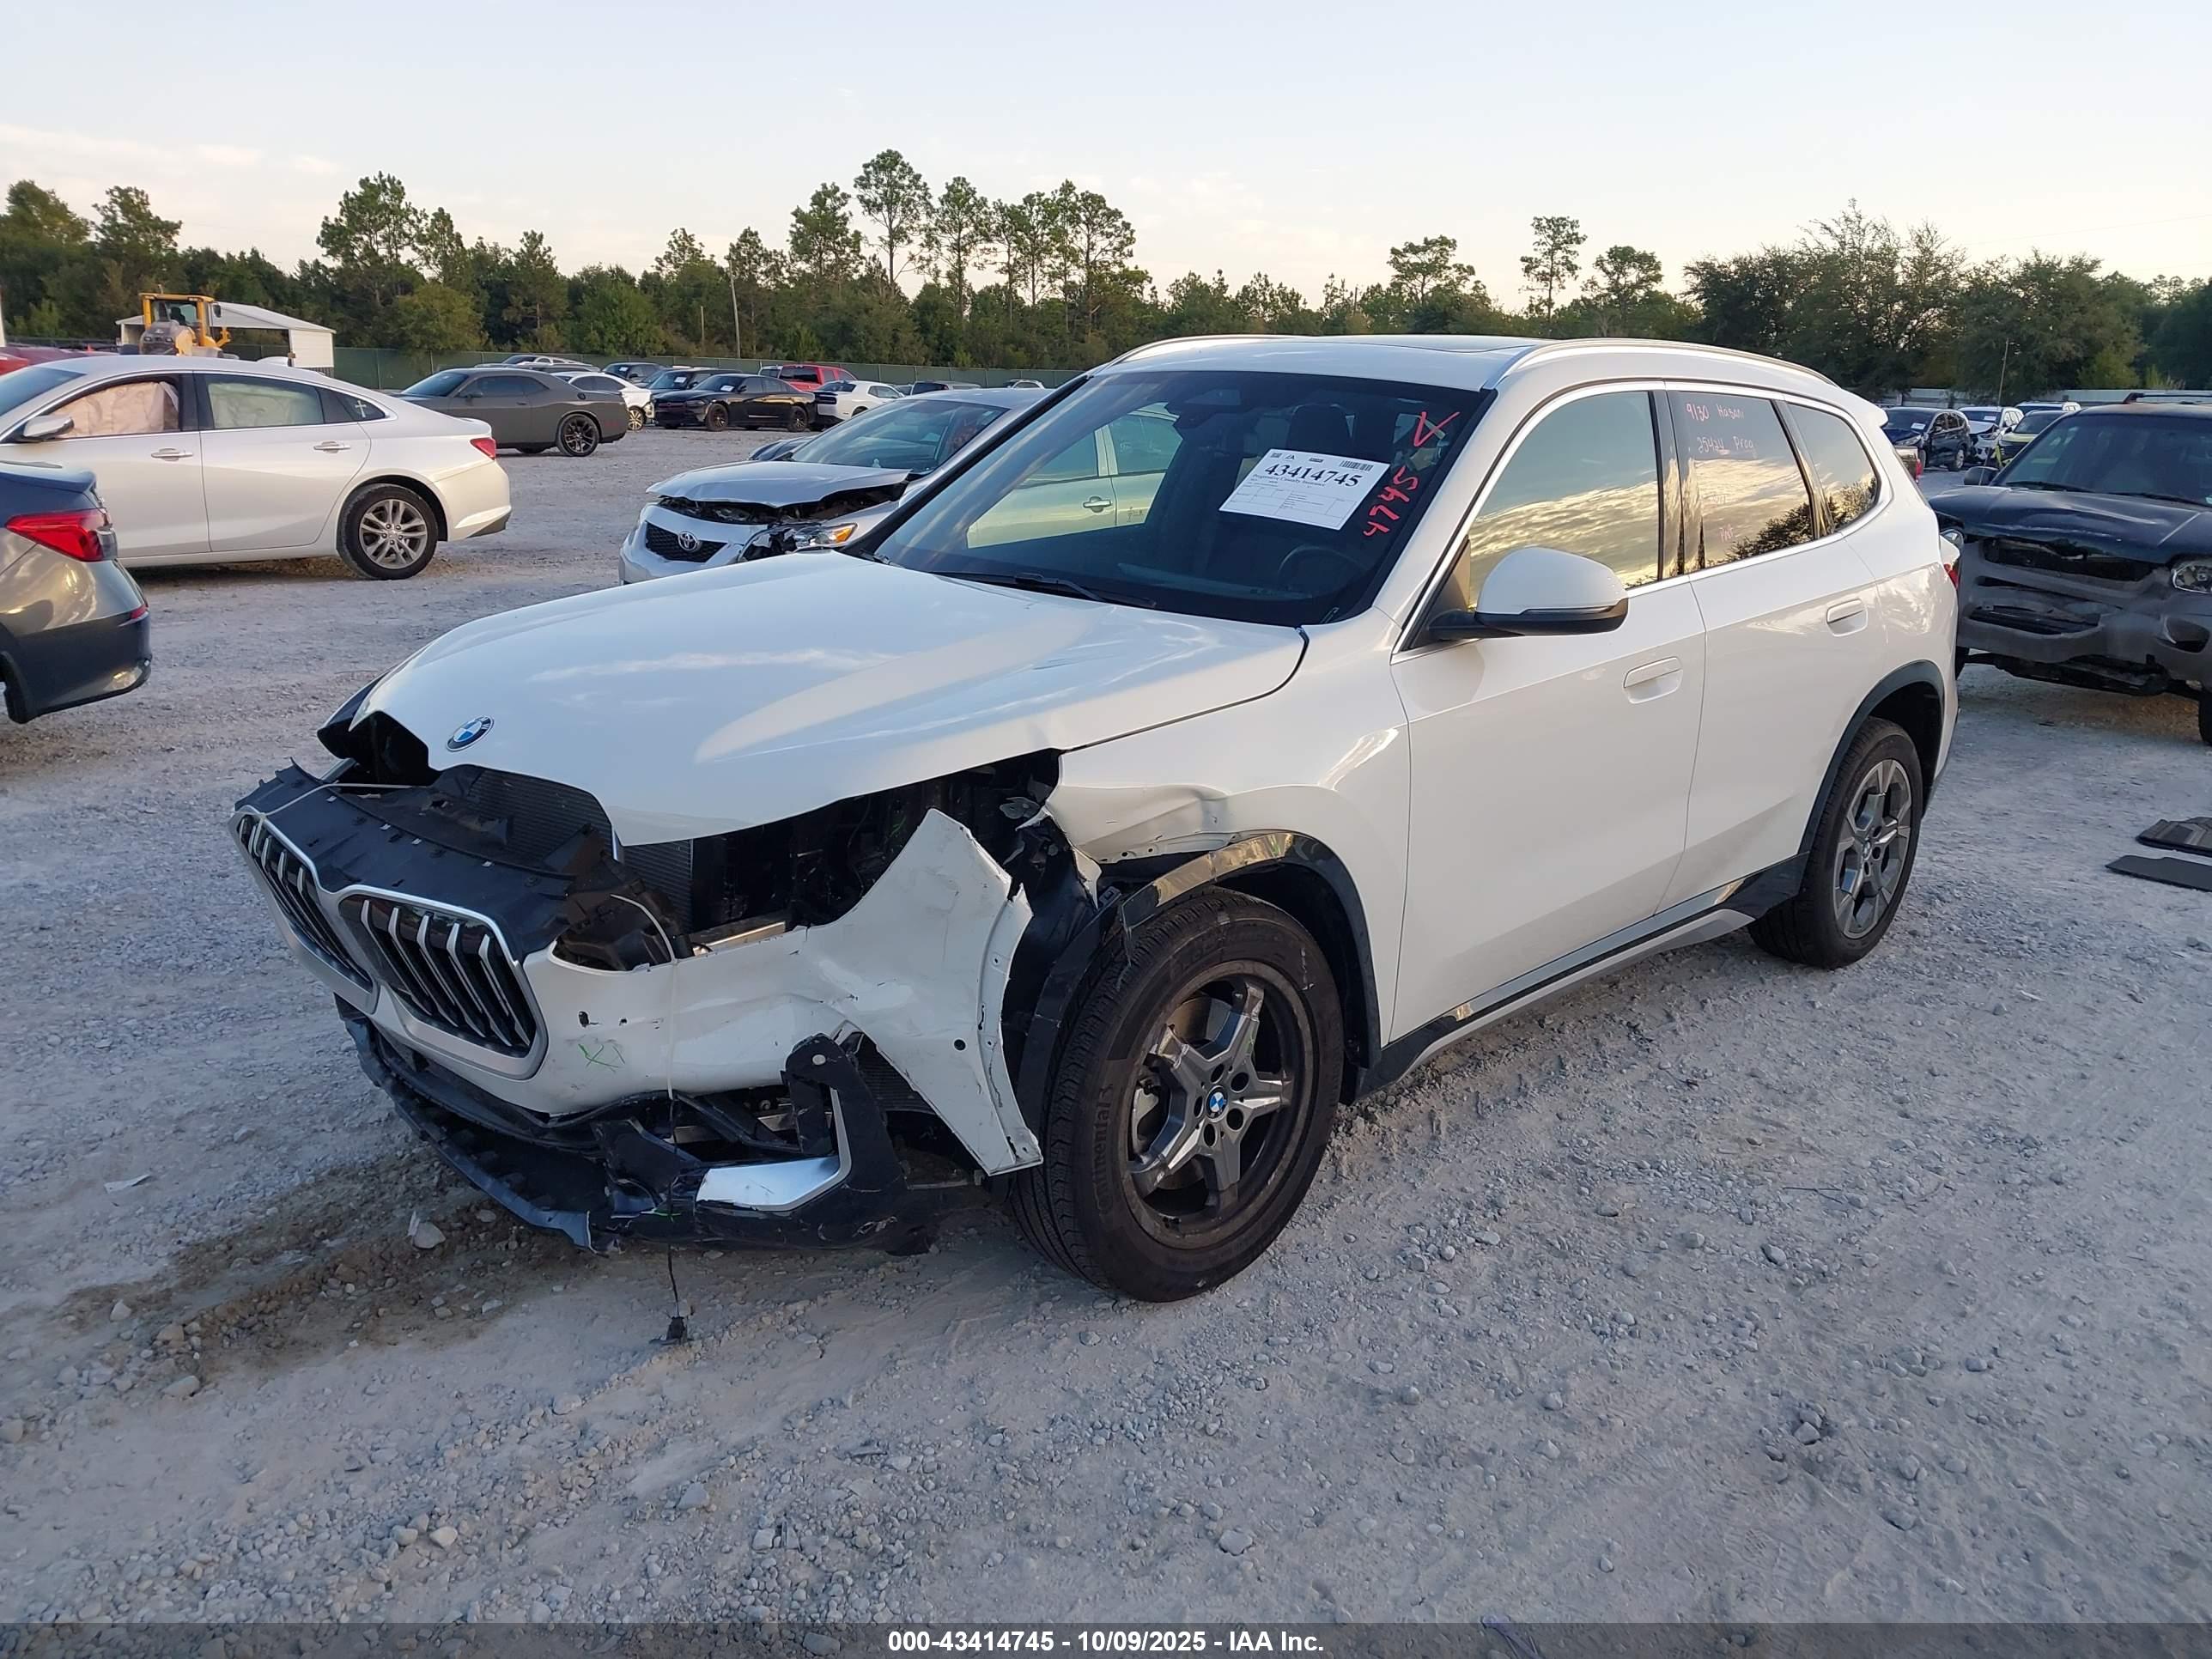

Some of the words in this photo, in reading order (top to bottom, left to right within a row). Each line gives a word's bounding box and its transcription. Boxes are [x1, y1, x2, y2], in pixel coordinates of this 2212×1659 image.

[1686, 403, 1710, 422] 9/30
[1265, 463, 1363, 488] 43414745
[1363, 465, 1419, 537] 4745
